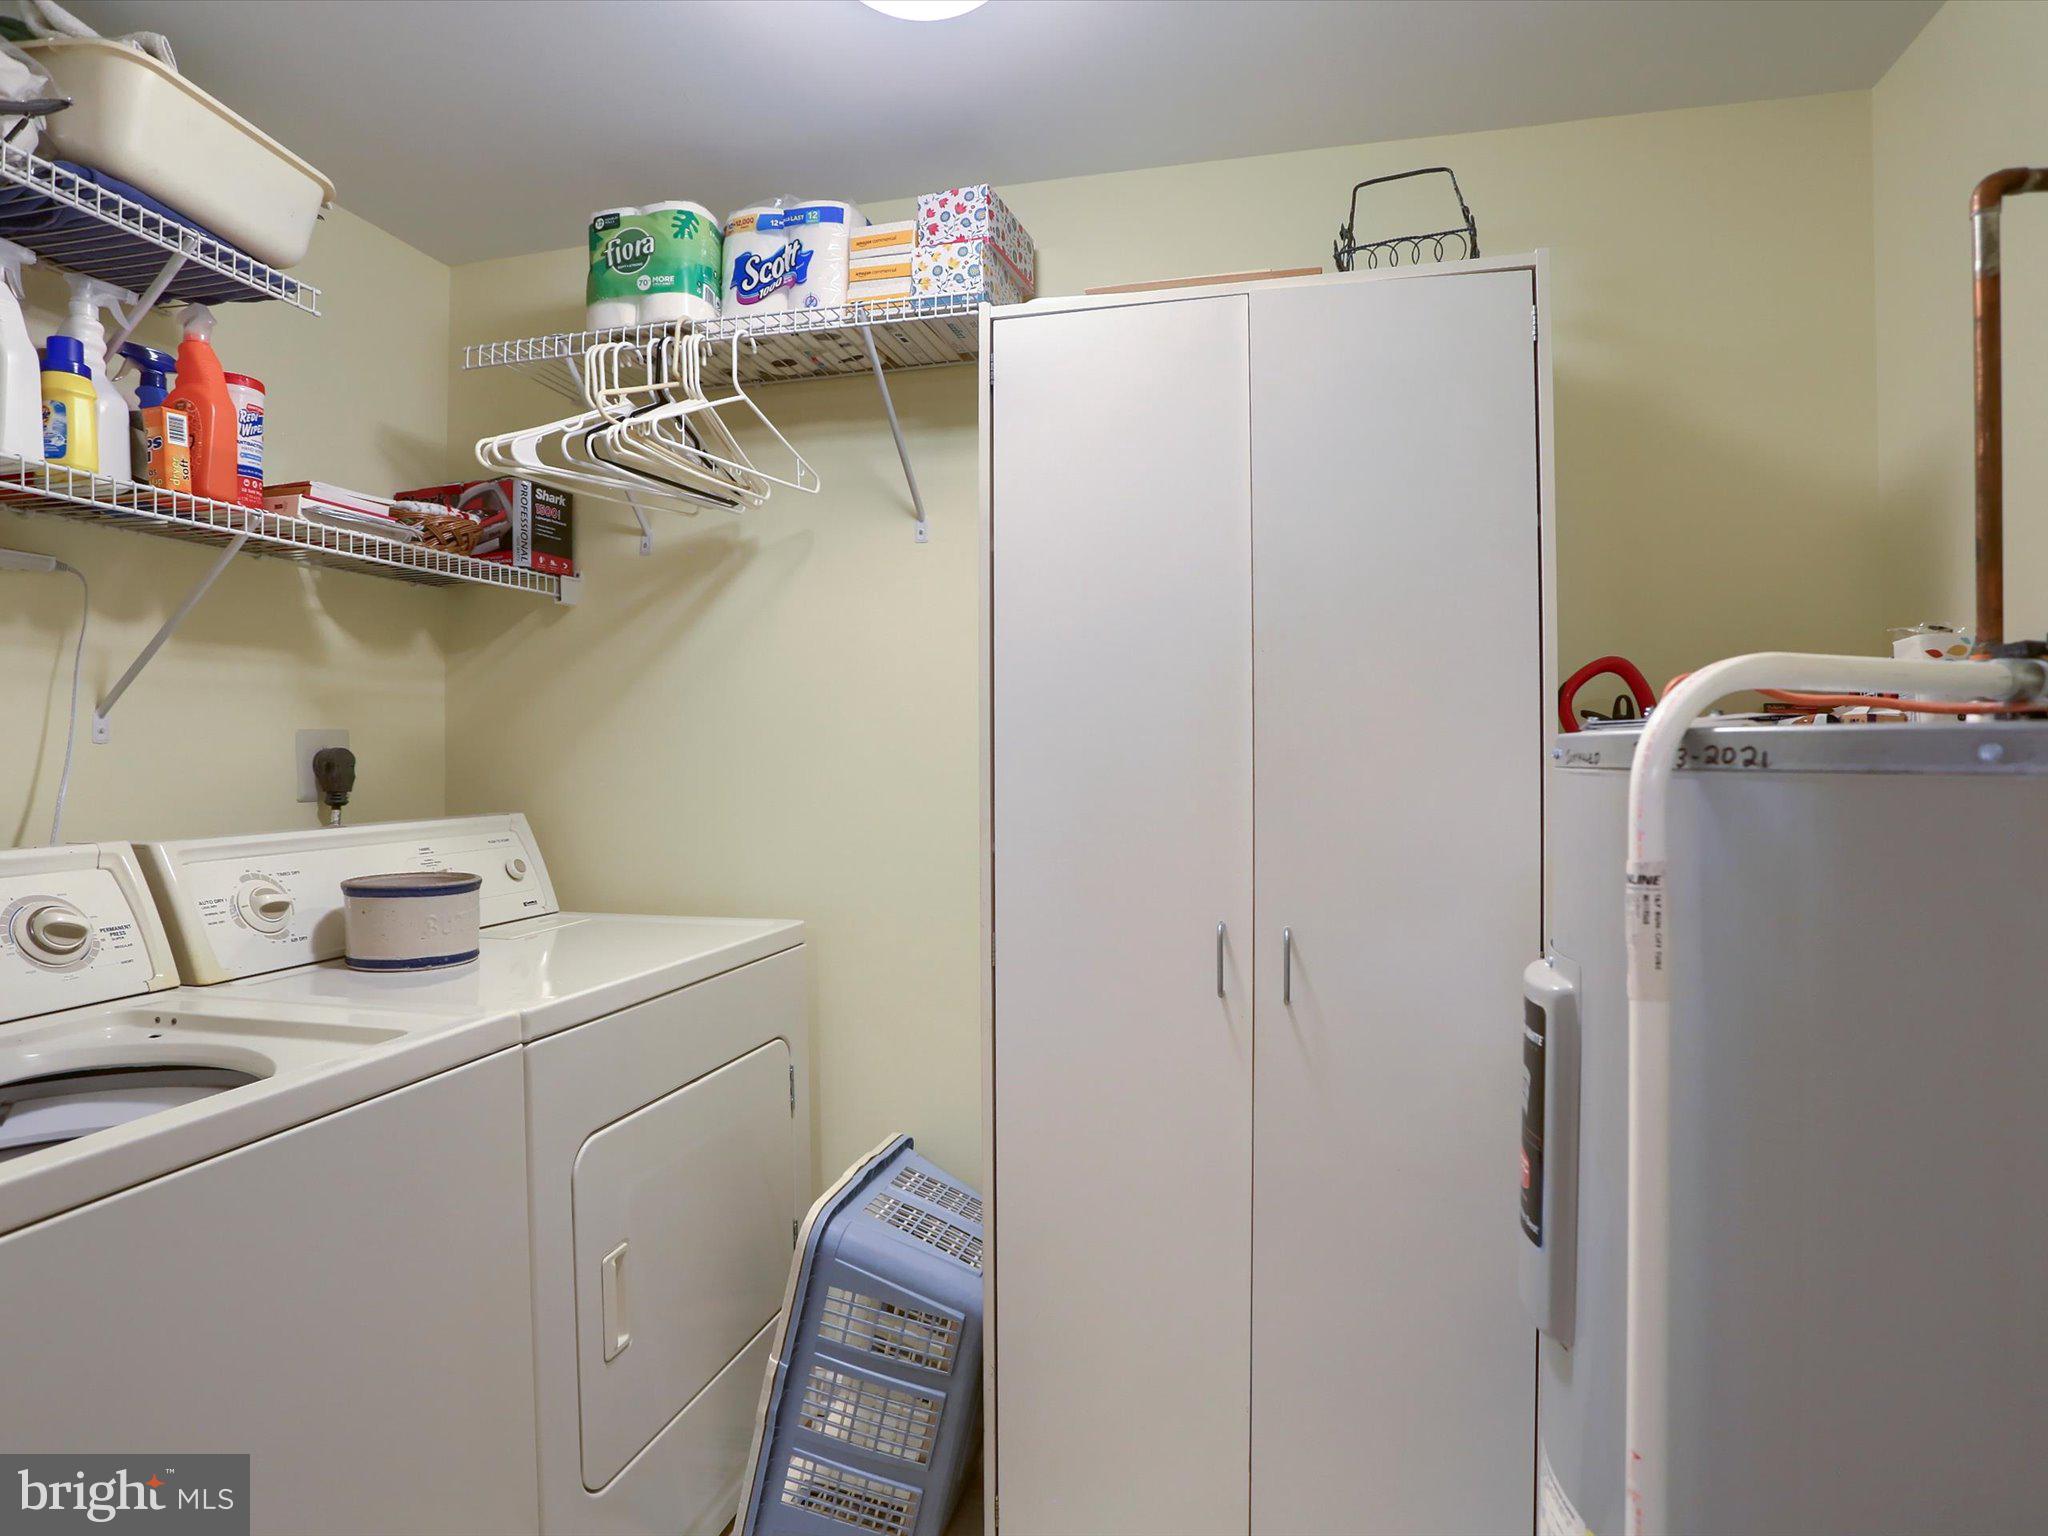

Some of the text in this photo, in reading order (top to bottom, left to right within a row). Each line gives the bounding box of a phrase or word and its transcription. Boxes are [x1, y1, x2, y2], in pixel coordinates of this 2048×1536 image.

[808, 211, 818, 220] 12
[604, 236, 654, 267] fiora
[742, 239, 800, 291] Scott
[652, 275, 675, 283] MORE
[759, 277, 783, 298] 1000
[179, 459, 190, 481] soft
[535, 488, 567, 506] Shark
[520, 483, 529, 562] PROFESSIONAL
[99, 924, 132, 933] PERMANENT
